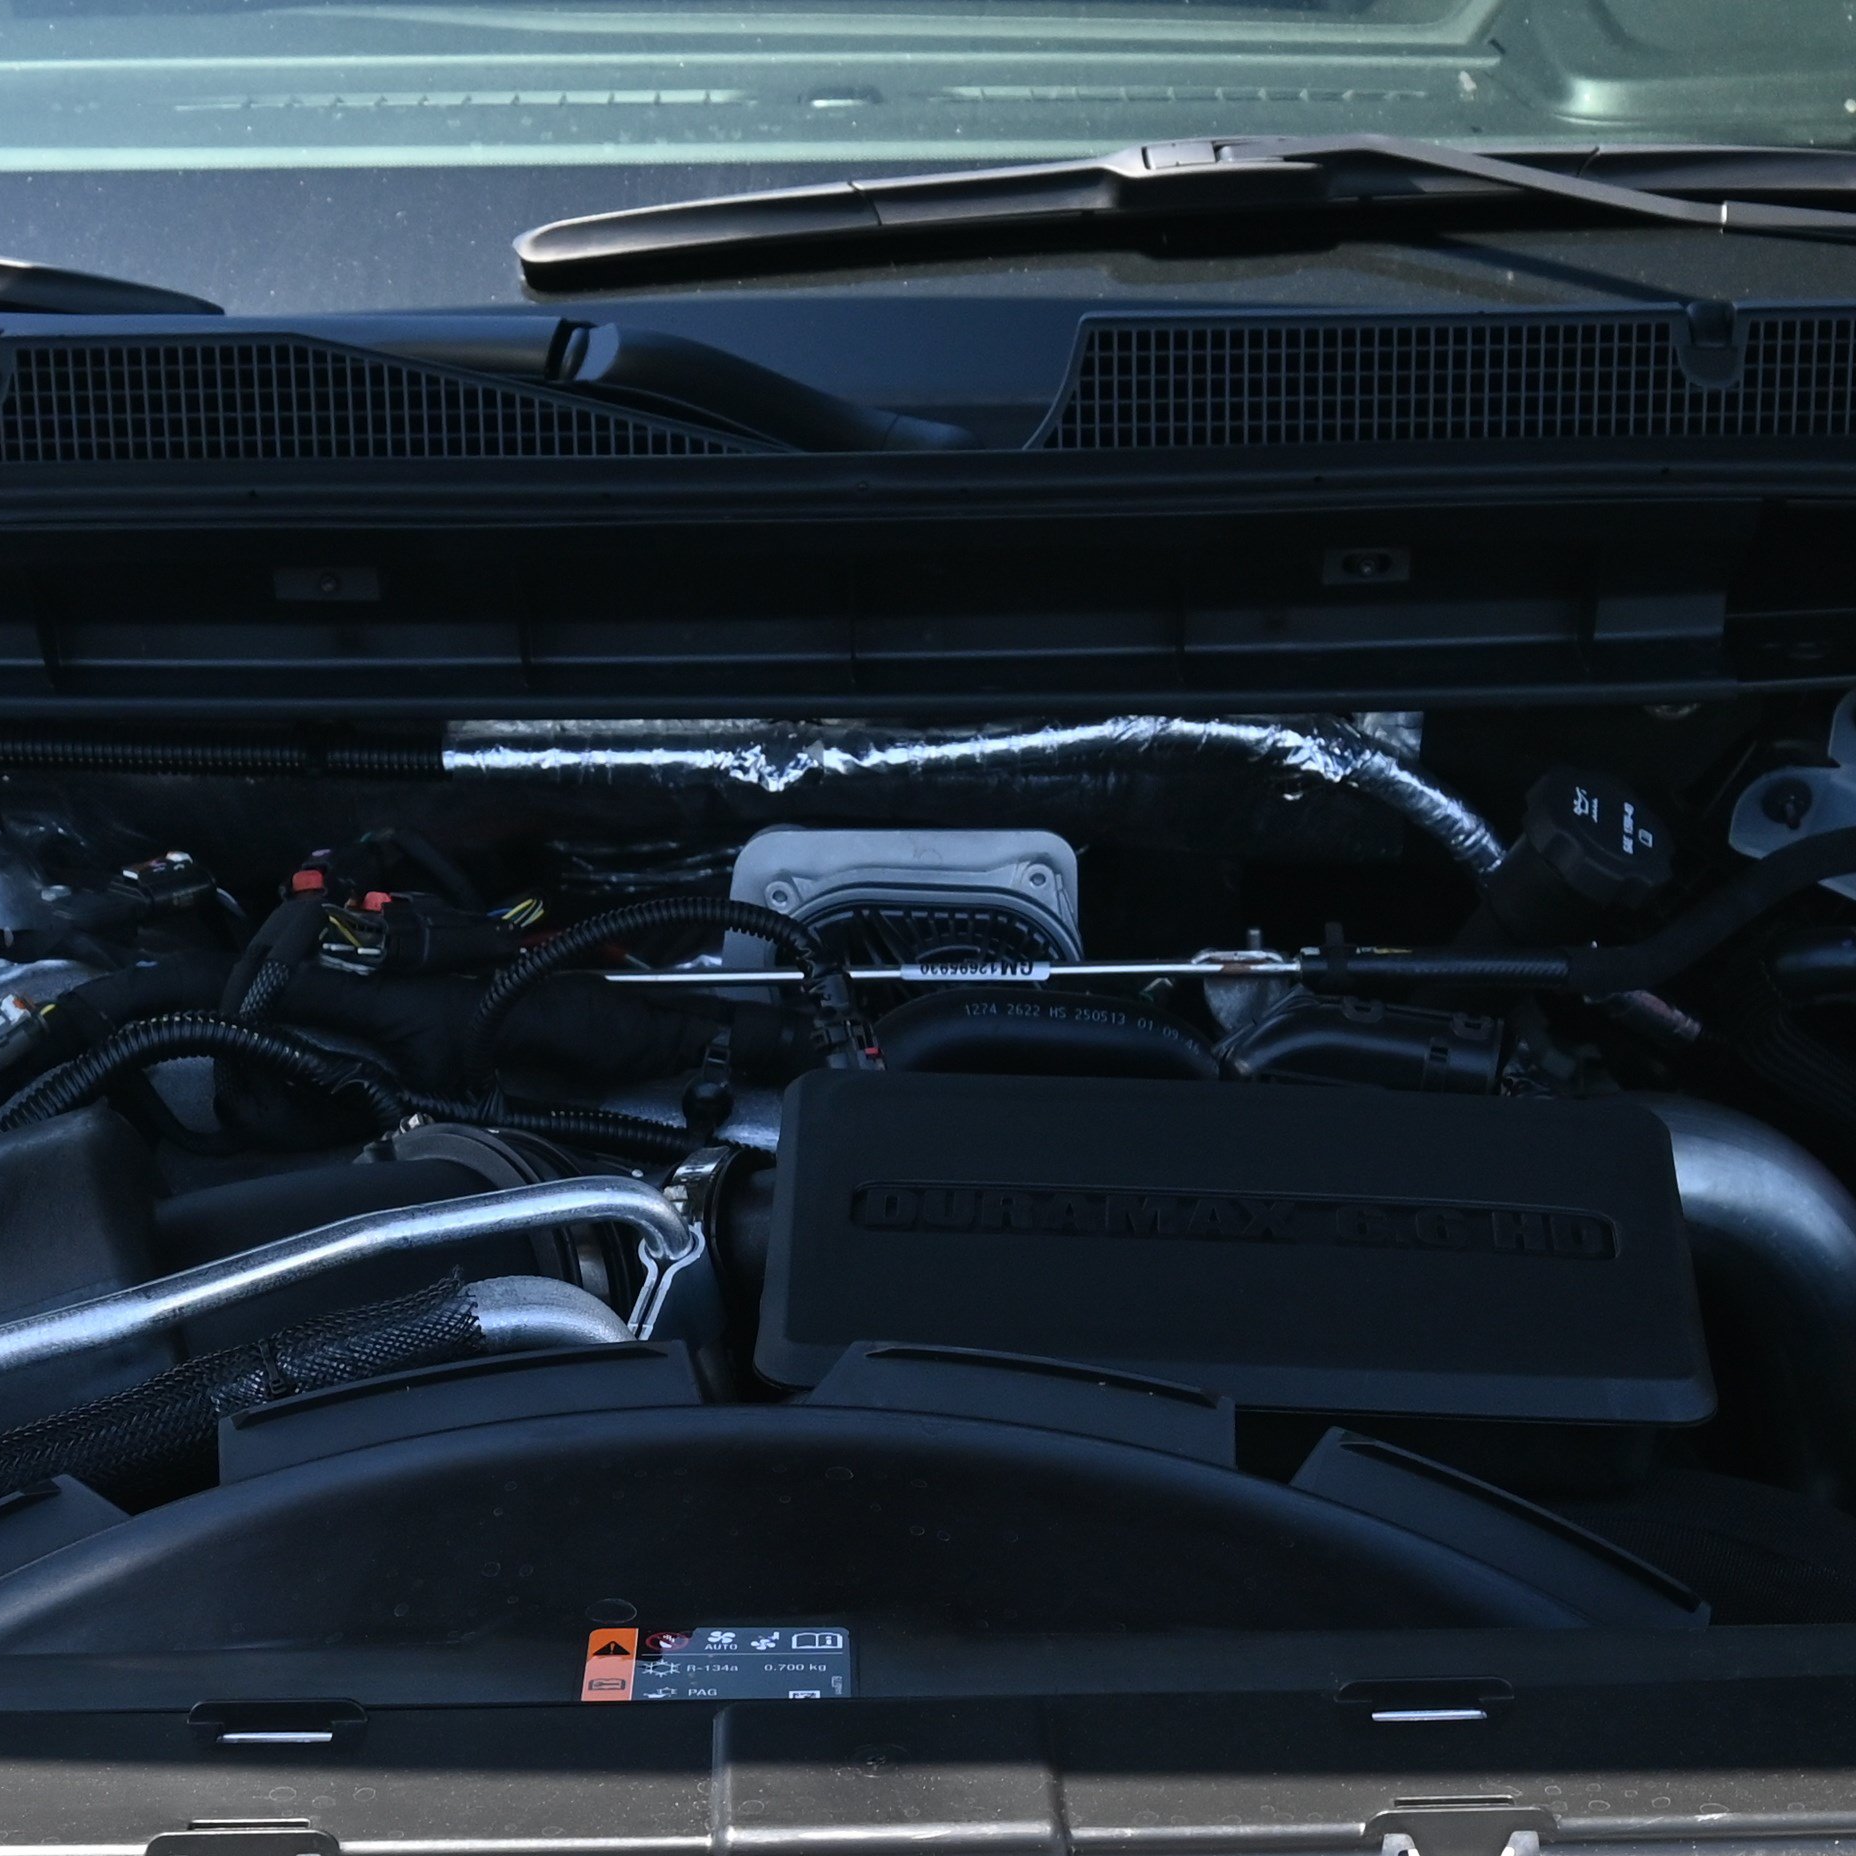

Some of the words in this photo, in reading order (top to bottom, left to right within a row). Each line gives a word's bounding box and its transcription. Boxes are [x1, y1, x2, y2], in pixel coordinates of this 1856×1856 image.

[863, 1186, 1298, 1240] DURAMAX
[1335, 1204, 1470, 1252] 6.6
[1491, 1211, 1617, 1260] HD
[704, 1642, 738, 1651] AUTO
[686, 1662, 739, 1673] R-134a
[764, 1663, 805, 1672] 0.700
[809, 1663, 827, 1673] kg
[687, 1687, 718, 1697] PAG
